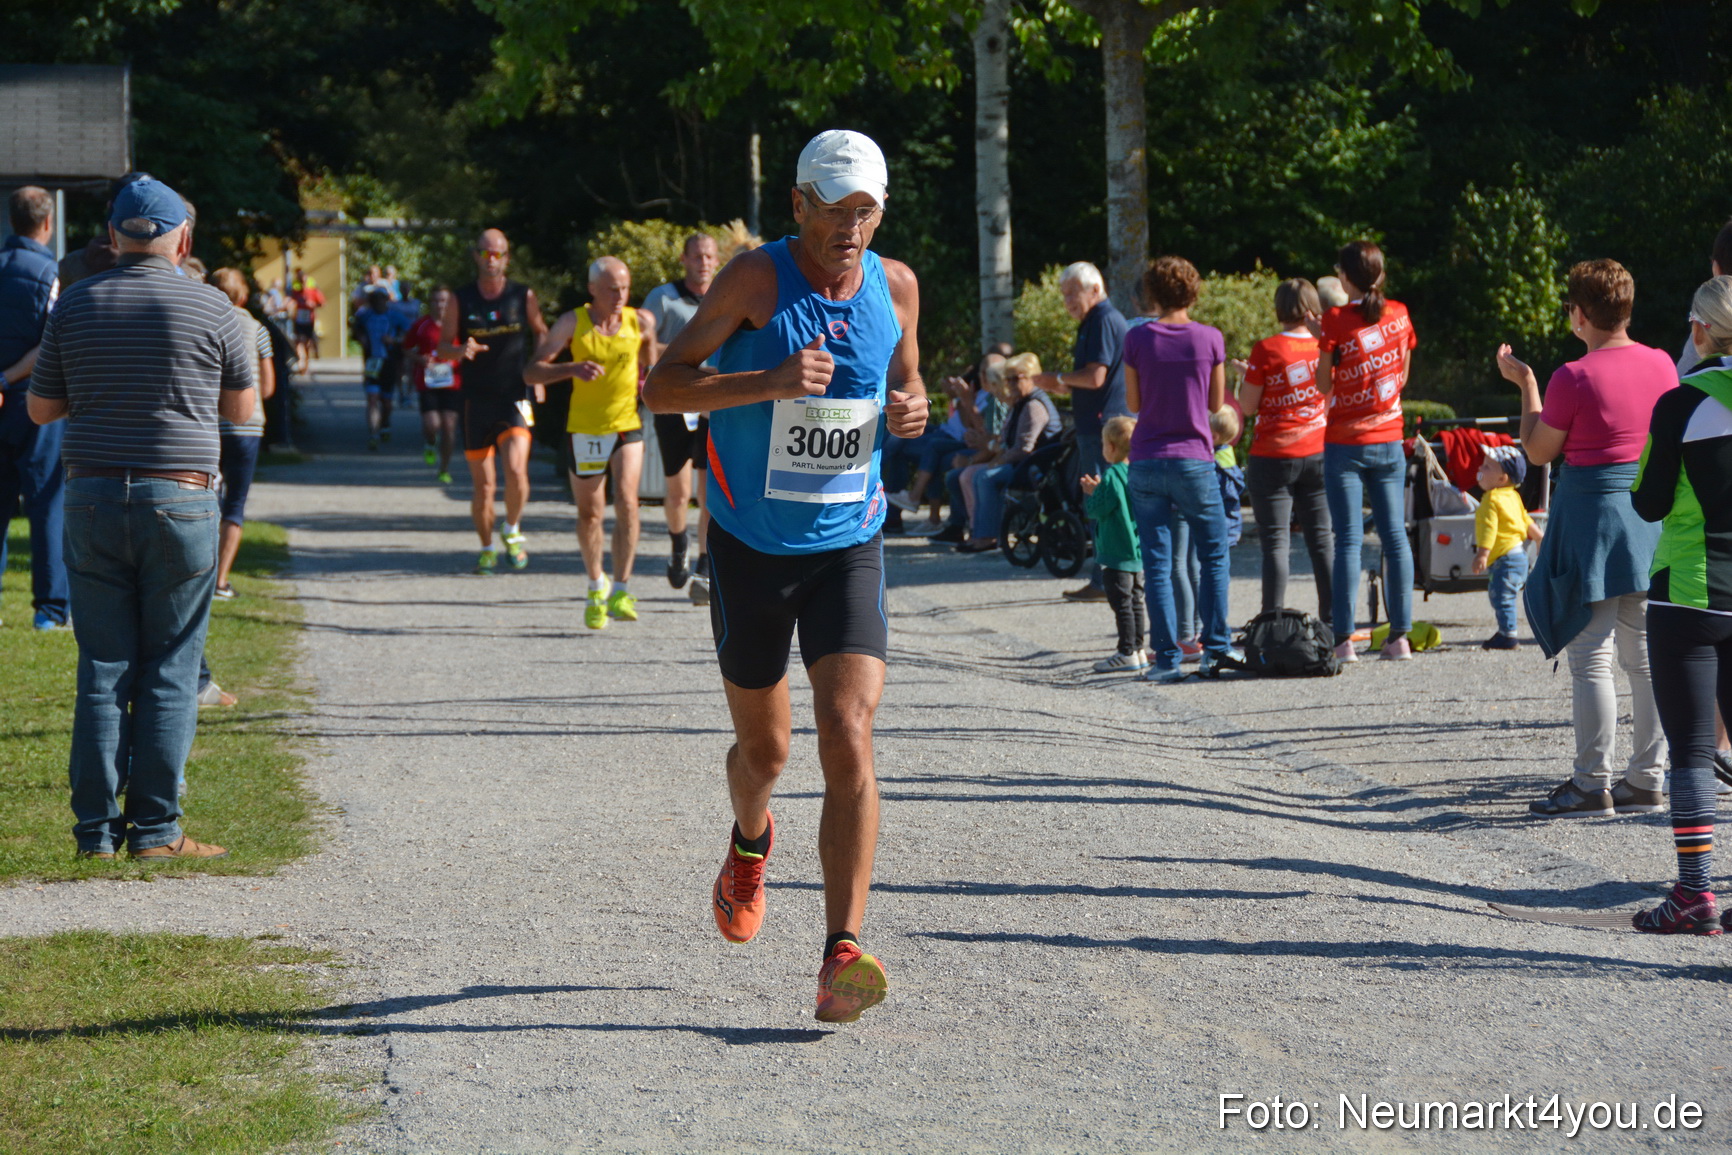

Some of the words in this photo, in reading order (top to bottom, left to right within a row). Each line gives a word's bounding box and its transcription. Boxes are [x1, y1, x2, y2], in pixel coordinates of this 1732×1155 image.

[806, 407, 852, 419] BOCK
[587, 441, 602, 455] 71
[786, 426, 861, 459] 3008
[791, 461, 815, 470] PARTL
